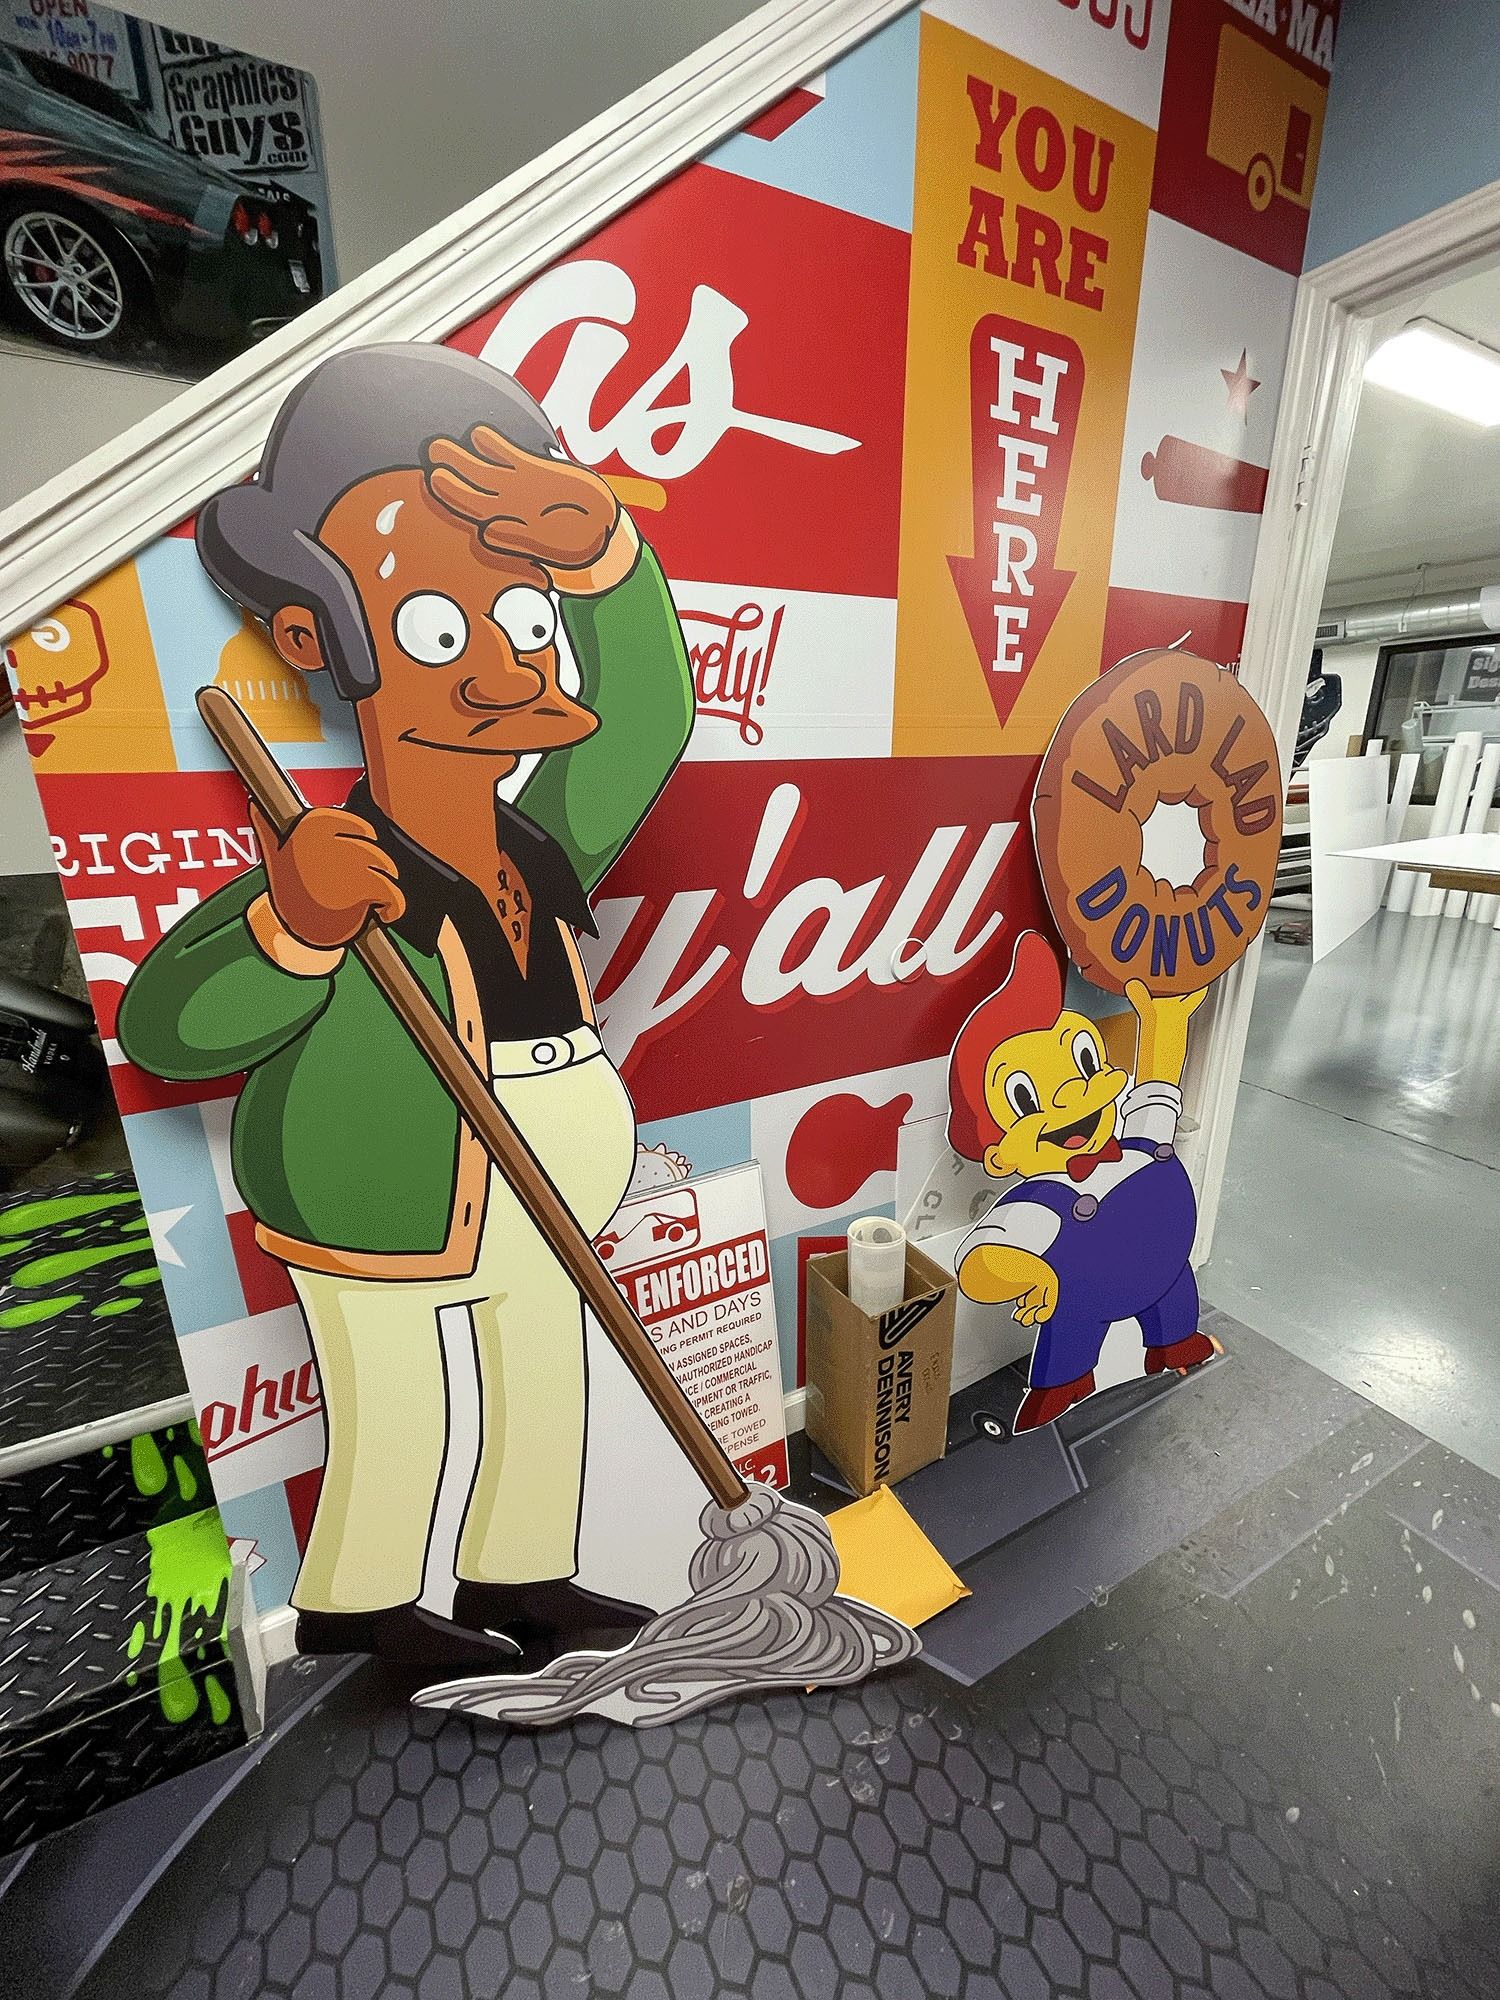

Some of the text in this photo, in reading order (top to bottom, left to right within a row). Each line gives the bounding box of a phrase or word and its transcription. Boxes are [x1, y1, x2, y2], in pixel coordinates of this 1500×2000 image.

[168, 63, 300, 117] Graphics
[180, 111, 304, 165] Guys
[967, 74, 1115, 214] YOU
[957, 186, 1109, 312] ARE
[990, 336, 1069, 673] HERE
[1467, 676, 1500, 689] Des
[1472, 656, 1500, 673] Sig
[1071, 682, 1276, 836] LARD LAD
[1076, 863, 1261, 976] DONUTS
[634, 1239, 766, 1318] ENFORCED
[660, 1312, 762, 1355] ING PERMIT REQUIRED
[668, 1311, 708, 1338] AND
[714, 1291, 762, 1321] DAYS
[676, 1346, 718, 1370] ASSIGNED
[720, 1334, 752, 1354] SPACES,
[676, 1339, 773, 1384] NAUTHORIZED HANDICAP
[692, 1369, 772, 1409] IPMENT OR TRAFFIC,
[704, 1361, 757, 1390] COMMERCIAL
[895, 1351, 914, 1423] AVERY
[704, 1392, 751, 1419] CREATING A
[731, 1402, 761, 1423] TOWED.
[731, 1418, 766, 1439] TOWED
[874, 1354, 895, 1482] DENNISON
[724, 1433, 759, 1454] PENSE
